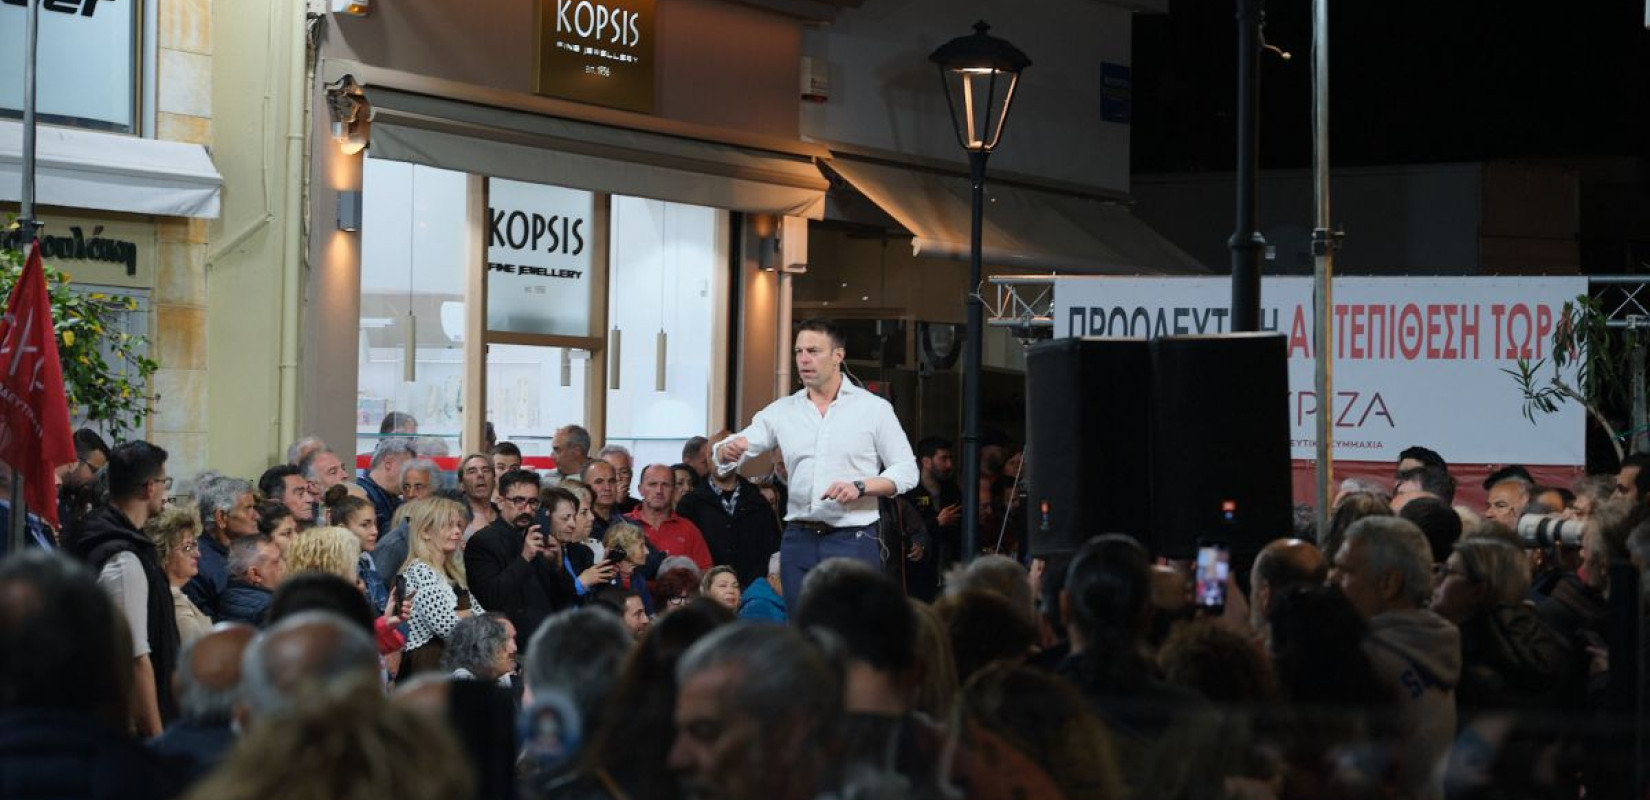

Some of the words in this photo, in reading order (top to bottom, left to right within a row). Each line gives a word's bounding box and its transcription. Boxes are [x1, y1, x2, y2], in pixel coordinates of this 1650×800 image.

[556, 0, 640, 48] KOPSIS
[556, 40, 581, 53] FINE
[583, 47, 639, 63] JEWELLERY
[488, 207, 584, 256] KOPSIS
[488, 261, 516, 274] FINE
[518, 264, 583, 279] JEWELLERY
[1287, 302, 1480, 361] ΑΤΕΠΙΘΕΣΗ
[1491, 302, 1578, 361] ΤΩΡ
